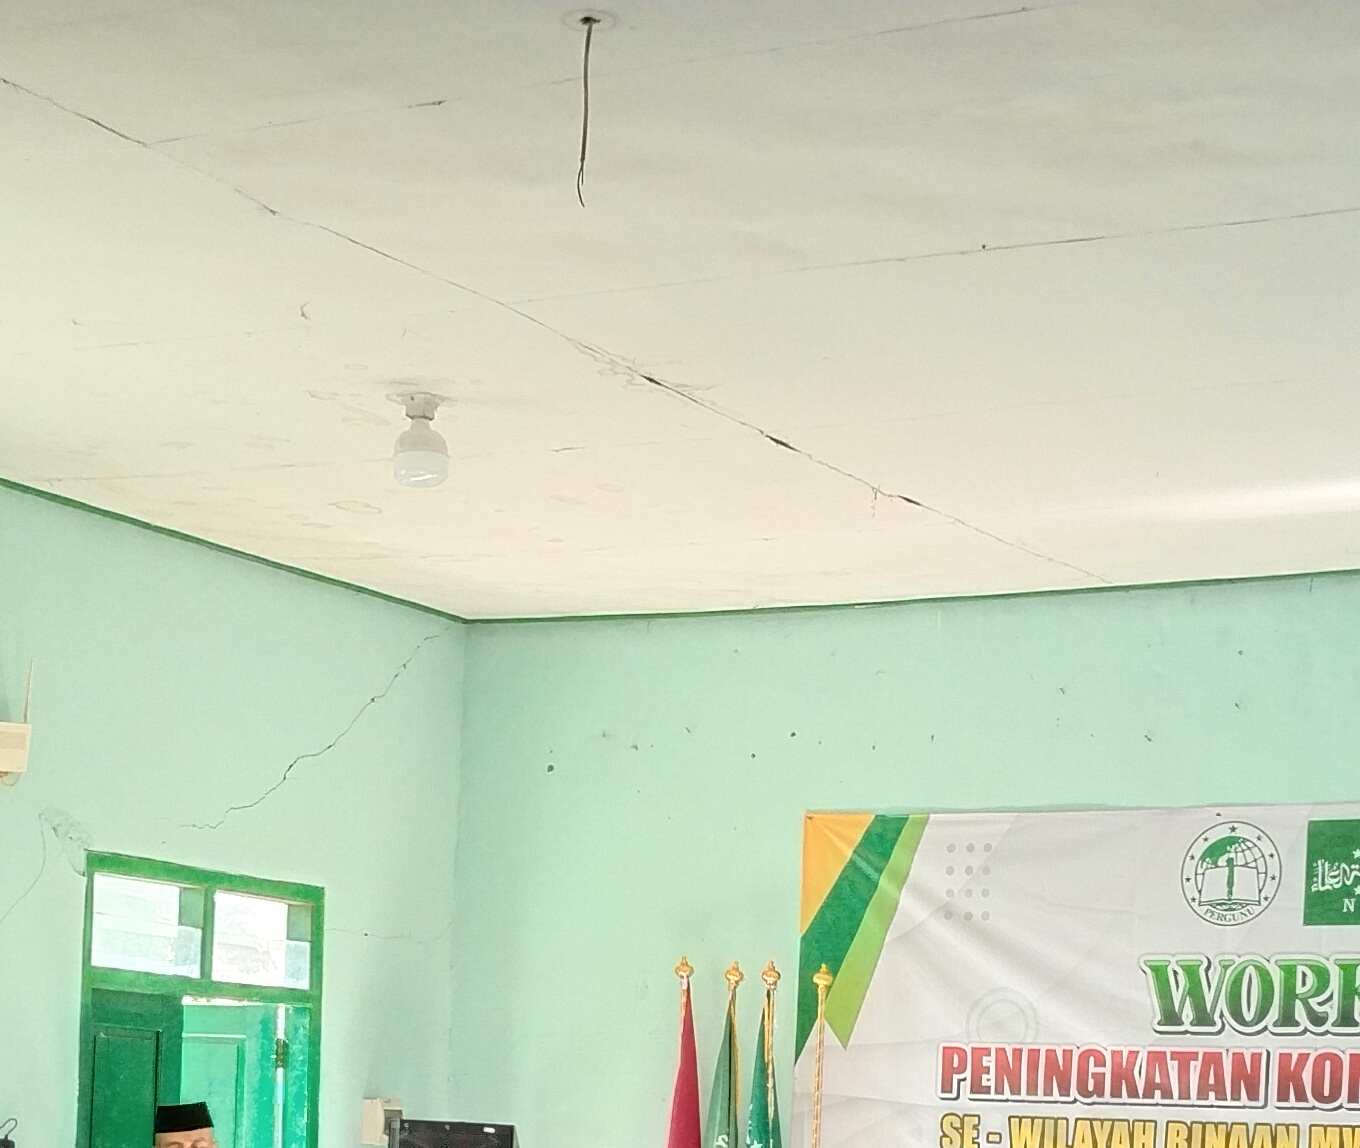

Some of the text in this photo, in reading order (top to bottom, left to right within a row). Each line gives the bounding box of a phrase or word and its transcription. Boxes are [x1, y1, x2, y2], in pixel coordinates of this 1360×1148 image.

[1342, 898, 1355, 913] N
[1203, 906, 1256, 924] PERGUNU
[939, 1045, 1265, 1102] PENINGKATAN
